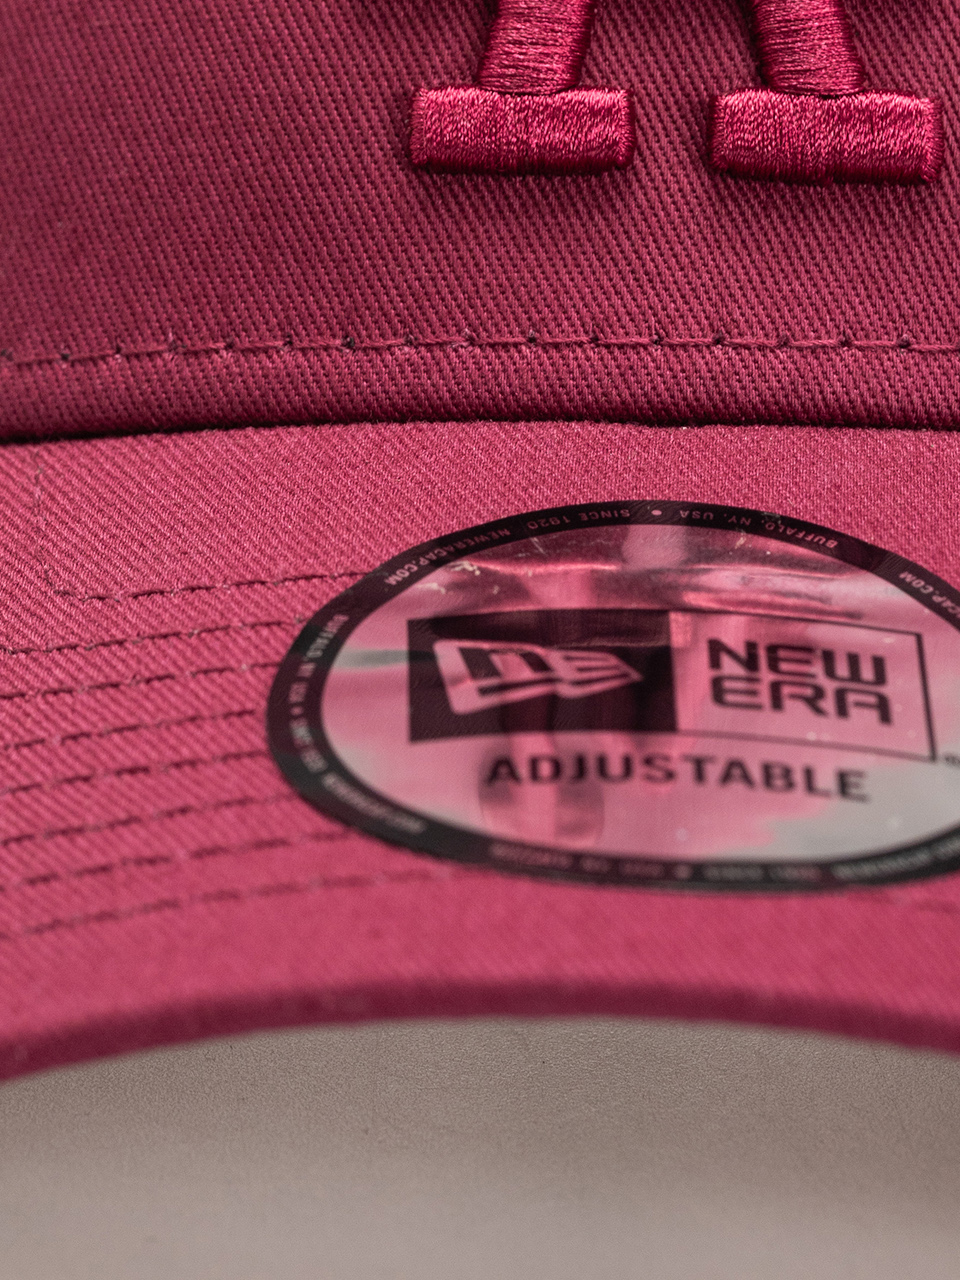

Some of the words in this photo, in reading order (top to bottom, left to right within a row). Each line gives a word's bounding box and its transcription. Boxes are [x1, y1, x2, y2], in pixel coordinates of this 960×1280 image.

[527, 515, 571, 530] 1920
[580, 508, 631, 521] SINCE
[679, 508, 715, 520] USA
[708, 637, 888, 687] NEW
[711, 675, 892, 725] ERA
[485, 752, 872, 803] ADJUSTABLE
